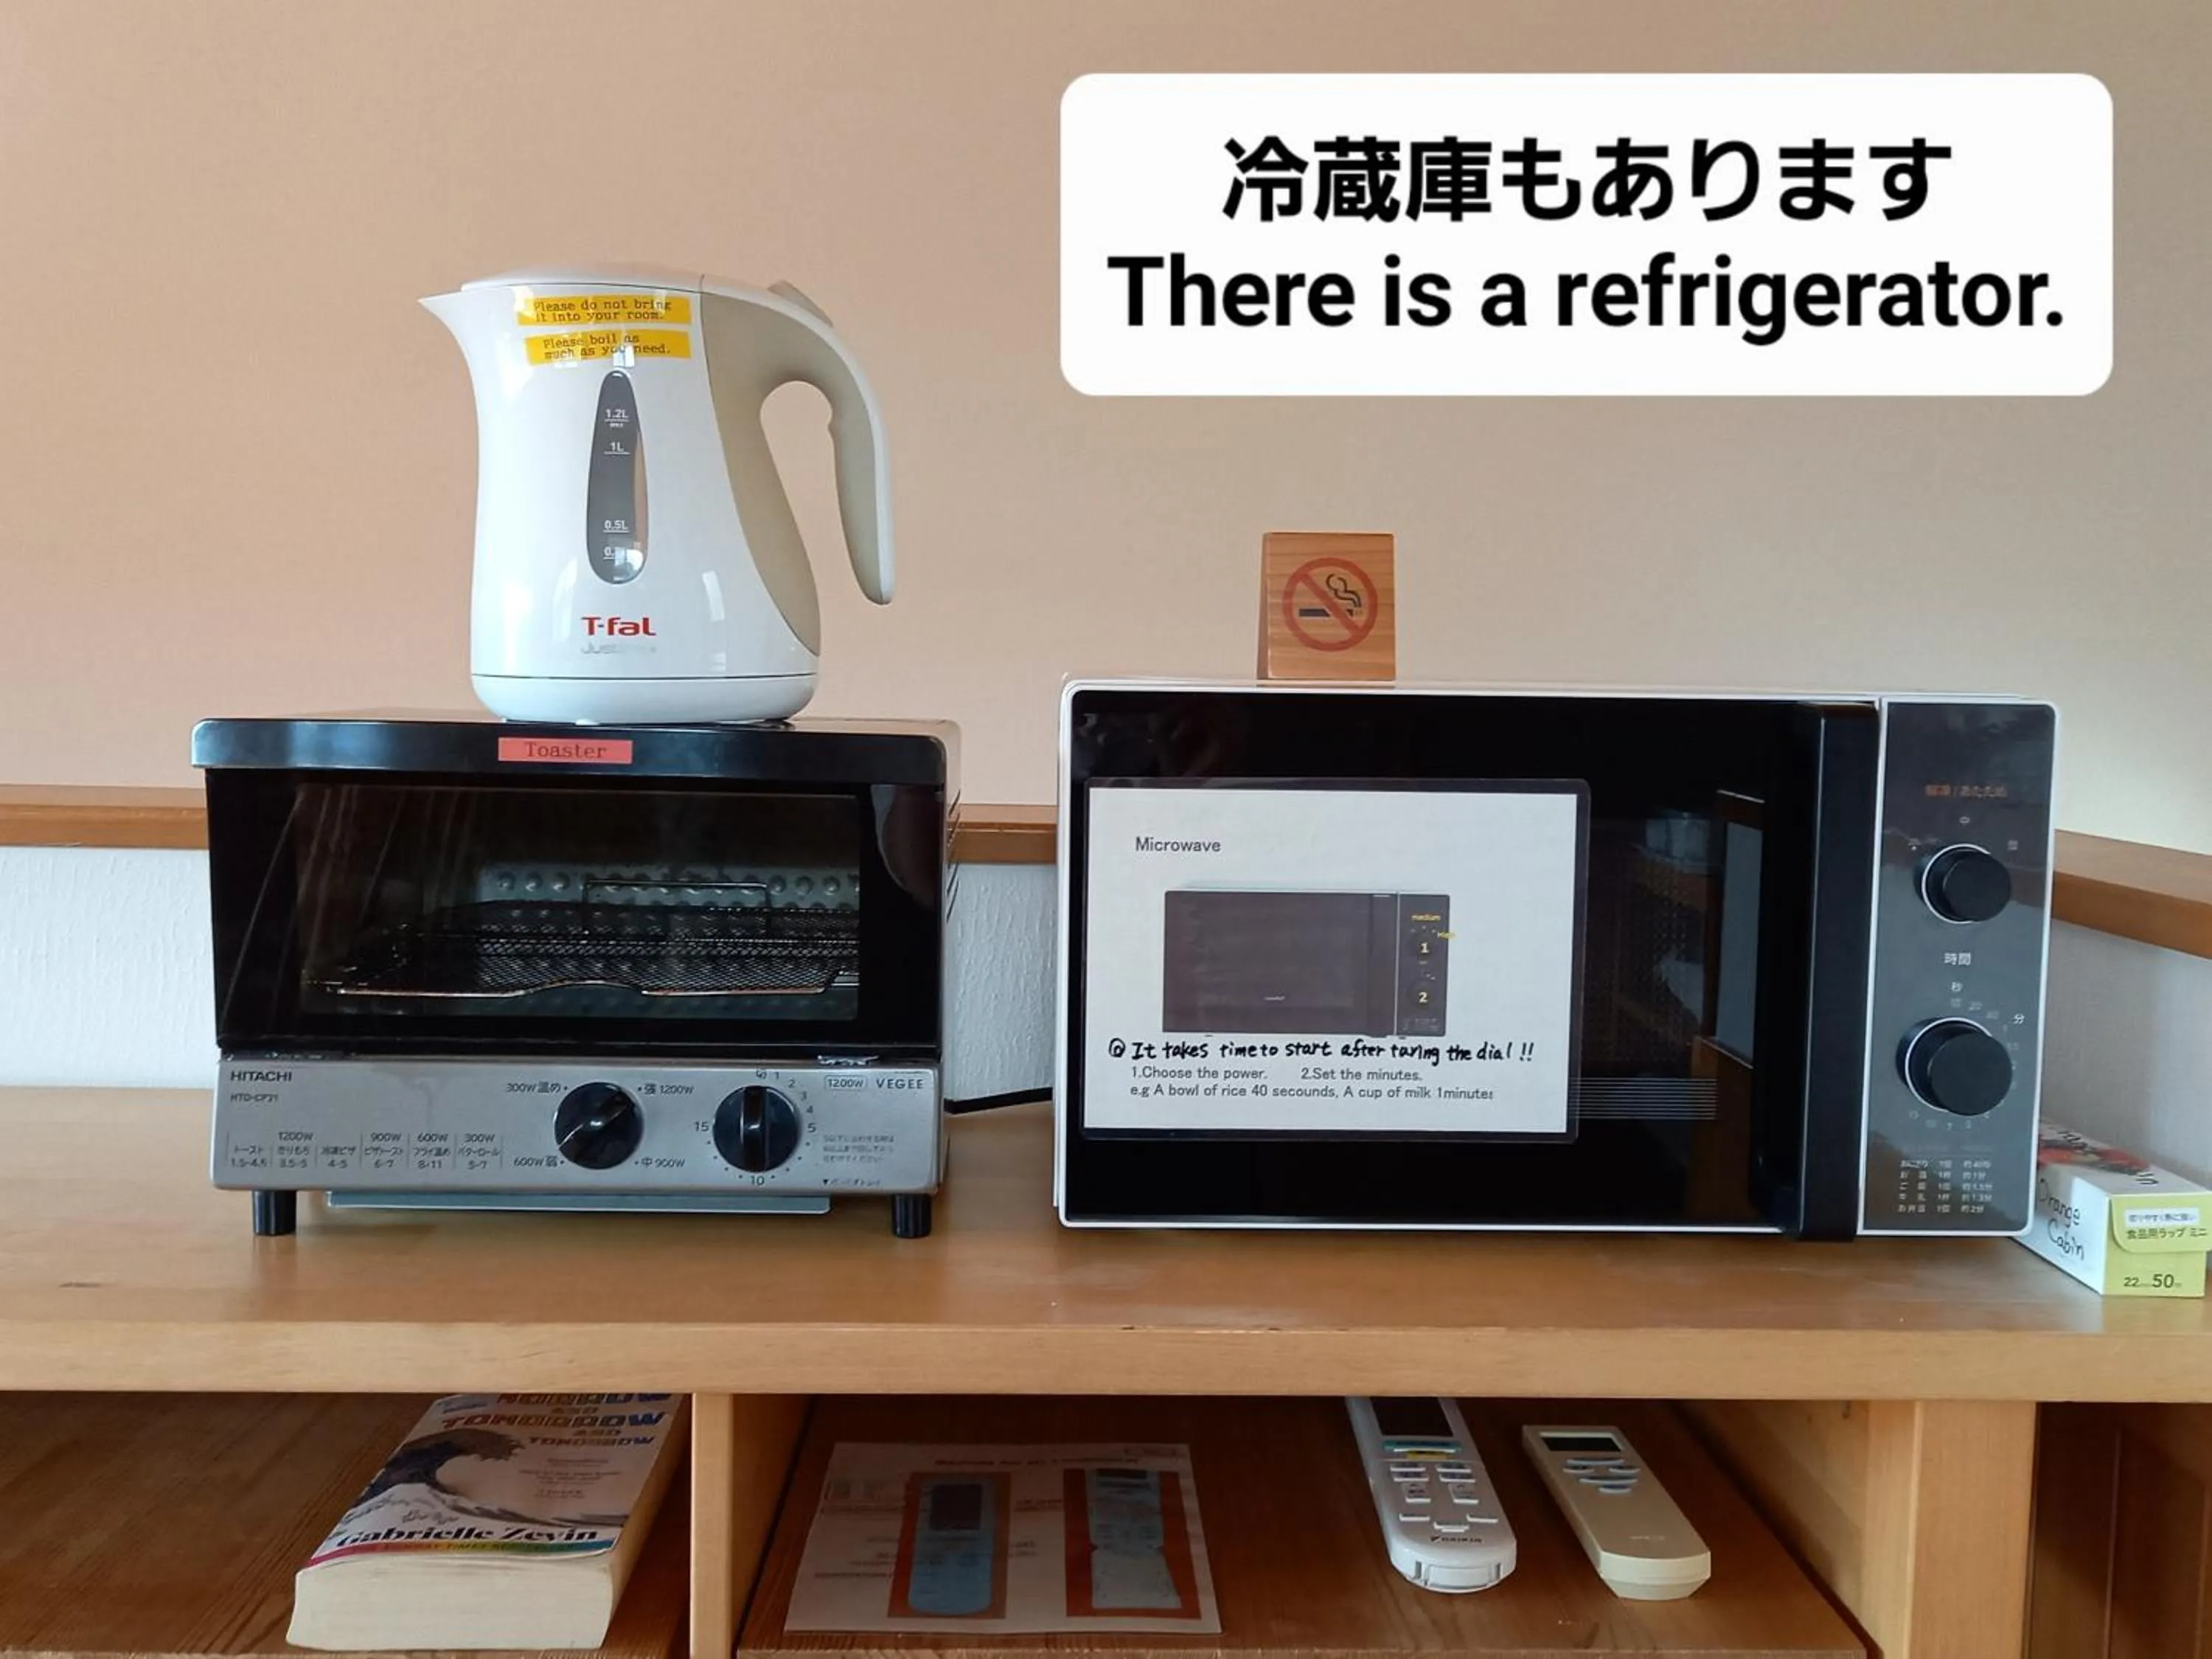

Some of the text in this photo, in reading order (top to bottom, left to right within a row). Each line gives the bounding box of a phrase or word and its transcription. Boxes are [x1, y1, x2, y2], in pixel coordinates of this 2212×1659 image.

[534, 299, 672, 312] Please do not bring
[552, 311, 581, 322] into
[588, 311, 619, 324] your
[627, 311, 664, 321] room.
[543, 333, 639, 349] Please boil as
[580, 346, 596, 356] as
[633, 344, 671, 355] need.
[605, 408, 629, 419] 1.2L
[611, 441, 624, 452] 1L
[604, 520, 629, 530] 0.5L
[581, 616, 657, 636] T-fal
[525, 741, 607, 759] Toaster
[1135, 836, 1221, 852] Microwave
[1420, 942, 1429, 953] 1
[1944, 953, 1972, 966] 時間
[1419, 992, 1427, 1003] 2
[1132, 1041, 1157, 1060] It
[1162, 1040, 1209, 1060] takes
[1285, 1040, 1332, 1057] start
[1340, 1038, 1386, 1058] after
[1447, 1043, 1472, 1062] the
[1476, 1040, 1512, 1060] dial
[231, 1071, 292, 1082] HITACHI
[1132, 1065, 1268, 1082] 1.Choose the power.
[1301, 1068, 1423, 1081] 2.Set the minutes.
[788, 1079, 796, 1088] 2
[827, 1077, 864, 1088] 1200W
[876, 1079, 923, 1090] VEGEE
[661, 1084, 694, 1094] 1200W
[1130, 1086, 1150, 1098] e.g
[1153, 1085, 1164, 1096] A
[1169, 1084, 1199, 1096] bowl
[1203, 1084, 1218, 1096] of
[1222, 1085, 1247, 1096] rice
[1251, 1085, 1267, 1096] 40
[1343, 1086, 1354, 1098] A
[1358, 1089, 1382, 1101] cup
[1387, 1086, 1401, 1099] of
[1405, 1086, 1431, 1099] milk
[695, 1121, 709, 1132] 15
[807, 1123, 816, 1133] 5
[279, 1132, 313, 1141] 1200W
[370, 1132, 402, 1142] 900W
[417, 1132, 448, 1143] 600W
[465, 1133, 495, 1143] 300W
[751, 1175, 765, 1186] 10
[2039, 1178, 2081, 1228] Orange
[2047, 1217, 2085, 1262] Cabin
[2152, 1273, 2174, 1288] 50
[336, 1526, 599, 1546] Gabrielle Zevin
